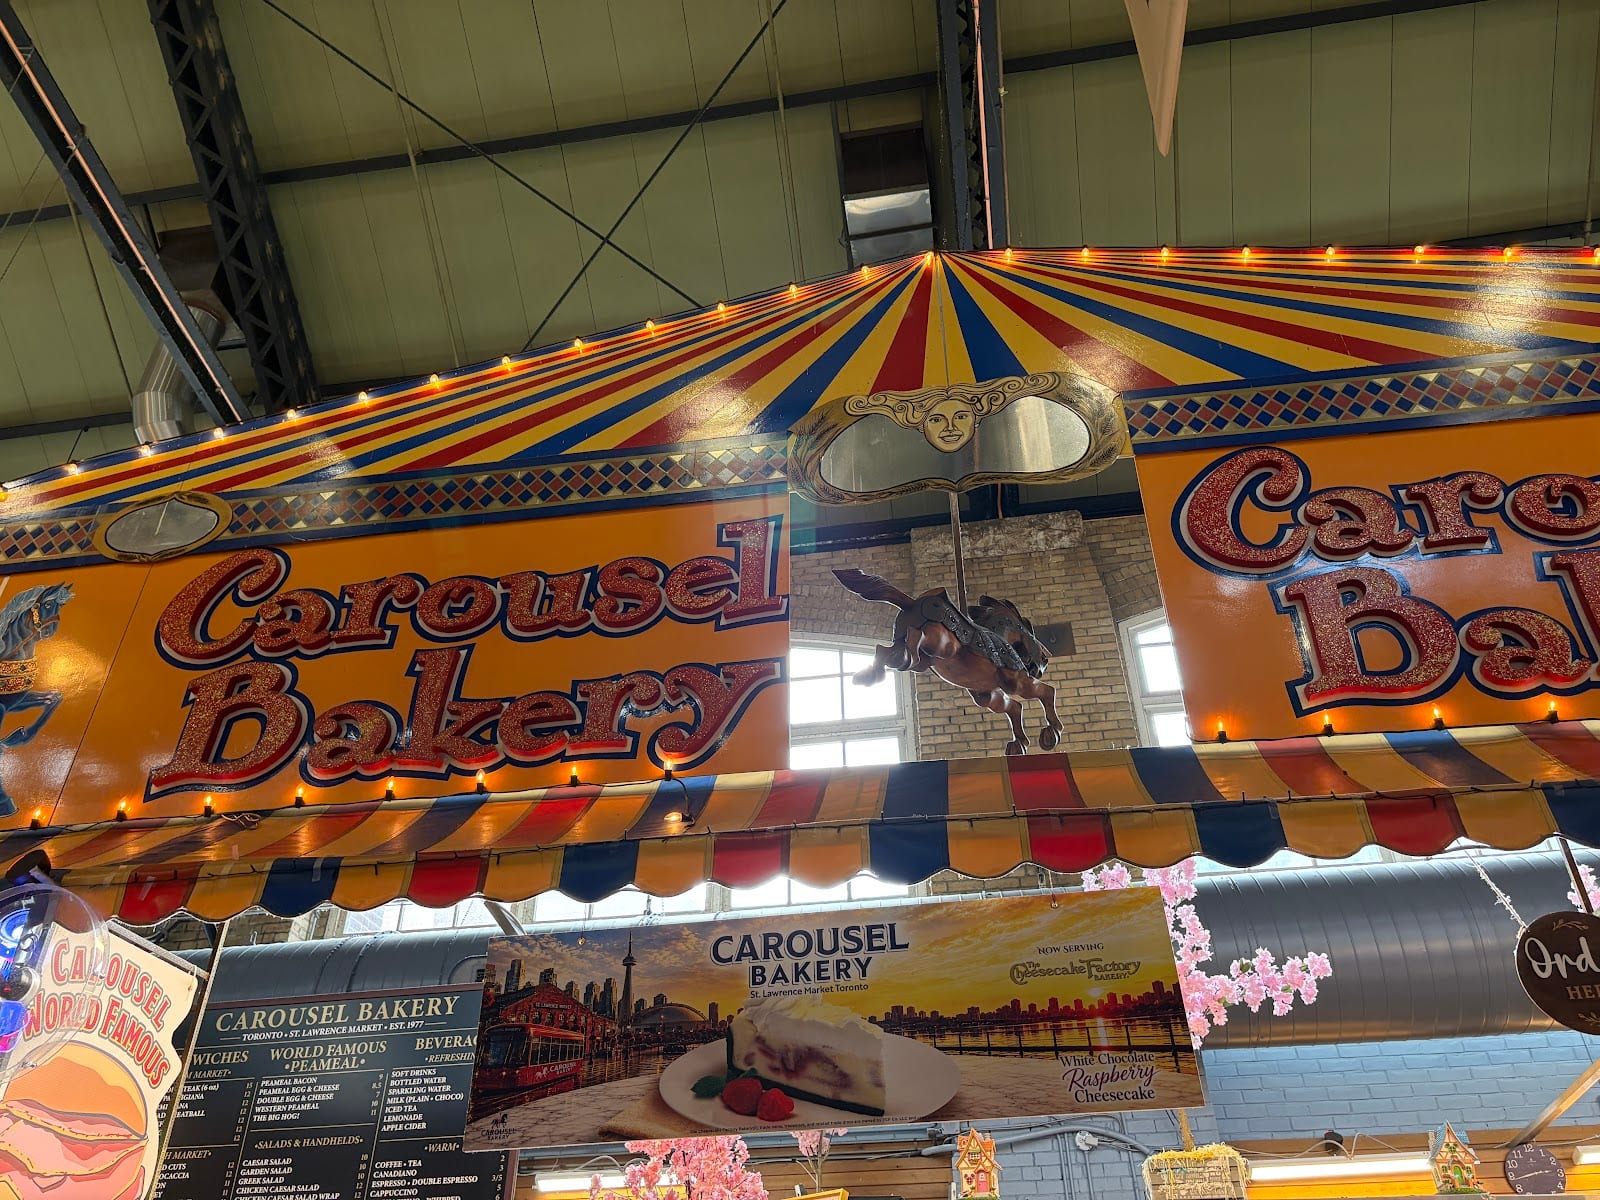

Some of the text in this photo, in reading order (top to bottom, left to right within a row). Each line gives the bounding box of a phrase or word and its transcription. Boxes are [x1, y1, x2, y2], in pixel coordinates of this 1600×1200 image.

[157, 516, 788, 668] Carousel
[148, 647, 787, 797] Bakery
[711, 923, 909, 965] CAROUSEL
[1038, 943, 1104, 955] NOW SERVING
[749, 957, 872, 987] BAKERY
[1010, 958, 1141, 985] Cheesecake Factory
[750, 983, 869, 999] St. Lawrence Market Toronto
[215, 996, 460, 1032] CAROUSEL BAKERY
[242, 1020, 424, 1041] TORONTO ST. LAWRENCE MARKET EST. 1977
[101, 997, 170, 1086] FAMOUS
[270, 1040, 387, 1061] WORLD FAMOUS
[192, 1050, 249, 1066] WICHES
[1059, 1052, 1155, 1067] White Chocolate
[391, 1069, 436, 1078] SOFT DRINKS
[1062, 1065, 1159, 1092] Raspberry
[261, 1078, 292, 1087] PEAMEAL
[259, 1087, 291, 1095] PEAMEAL
[313, 1084, 339, 1092] CHEESE
[388, 1087, 426, 1095] SPARKLING
[257, 1096, 284, 1104] DOUBLE
[307, 1093, 334, 1101] CHEESE
[405, 1095, 429, 1104] (PLAIN
[434, 1093, 464, 1101] CHOCO)
[1075, 1087, 1155, 1103] Cheesecake
[255, 1105, 287, 1113] WESTERN
[287, 1103, 319, 1111] PEAMEAL
[176, 1110, 205, 1118] EATBALL
[253, 1114, 267, 1122] THE
[268, 1113, 280, 1121] BIG
[383, 1114, 423, 1122] LEMONADE
[381, 1122, 426, 1132] APPLE CIDER
[481, 1127, 516, 1137] CAROUSEL
[257, 1136, 360, 1149] SALADS & HANDHELDS
[1523, 1143, 1534, 1153] 12
[1539, 1149, 1545, 1157] 1
[1512, 1150, 1523, 1159] 11
[242, 1159, 268, 1167] CAESAR
[375, 1161, 402, 1169] COFFEE
[1507, 1159, 1518, 1169] 10
[1549, 1156, 1557, 1166] 2
[168, 1163, 186, 1171] CUTS
[240, 1168, 270, 1176] GARDEN
[159, 1172, 189, 1180] OCACCIA
[373, 1170, 417, 1178] CANADIANO
[1557, 1168, 1564, 1178] 3
[238, 1177, 261, 1185] GREEK
[262, 1176, 284, 1184] SALAD
[372, 1180, 406, 1188] ESPRESSO
[412, 1177, 442, 1186] DOUBLE
[442, 1175, 478, 1184] ESPRESSO
[1557, 1181, 1564, 1190] 4
[236, 1186, 268, 1195] CHICKEN
[269, 1185, 296, 1193] CAESAR
[297, 1184, 320, 1192] SALAD
[370, 1188, 418, 1197] CAPPUCCINO
[1515, 1184, 1523, 1193] 8
[319, 1192, 340, 1200] WRAP
